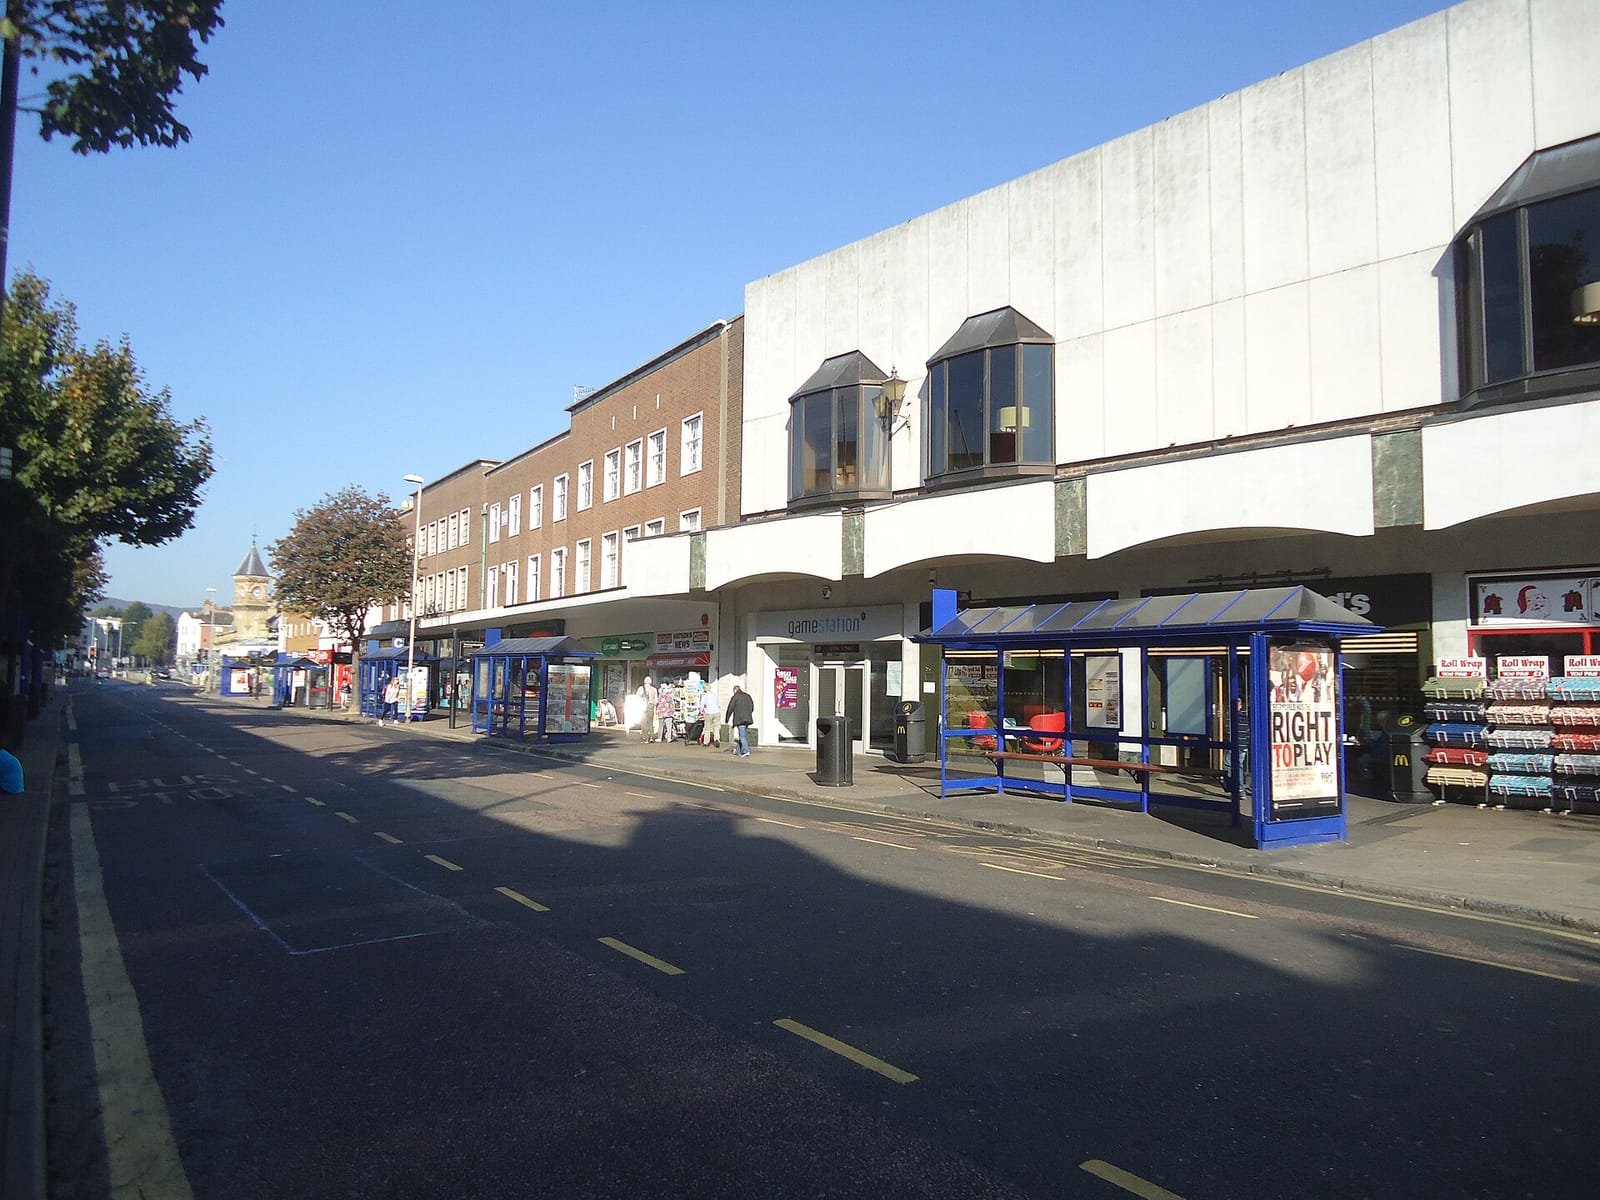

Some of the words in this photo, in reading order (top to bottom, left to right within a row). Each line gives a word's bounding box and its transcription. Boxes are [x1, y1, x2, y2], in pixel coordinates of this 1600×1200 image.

[788, 614, 861, 638] gamestation
[674, 640, 690, 648] NEWS
[1460, 660, 1483, 670] Wrap
[1502, 659, 1518, 667] Roll
[1521, 660, 1545, 670] Wrap
[1569, 659, 1587, 667] Roll
[1272, 711, 1332, 743] RIGHT
